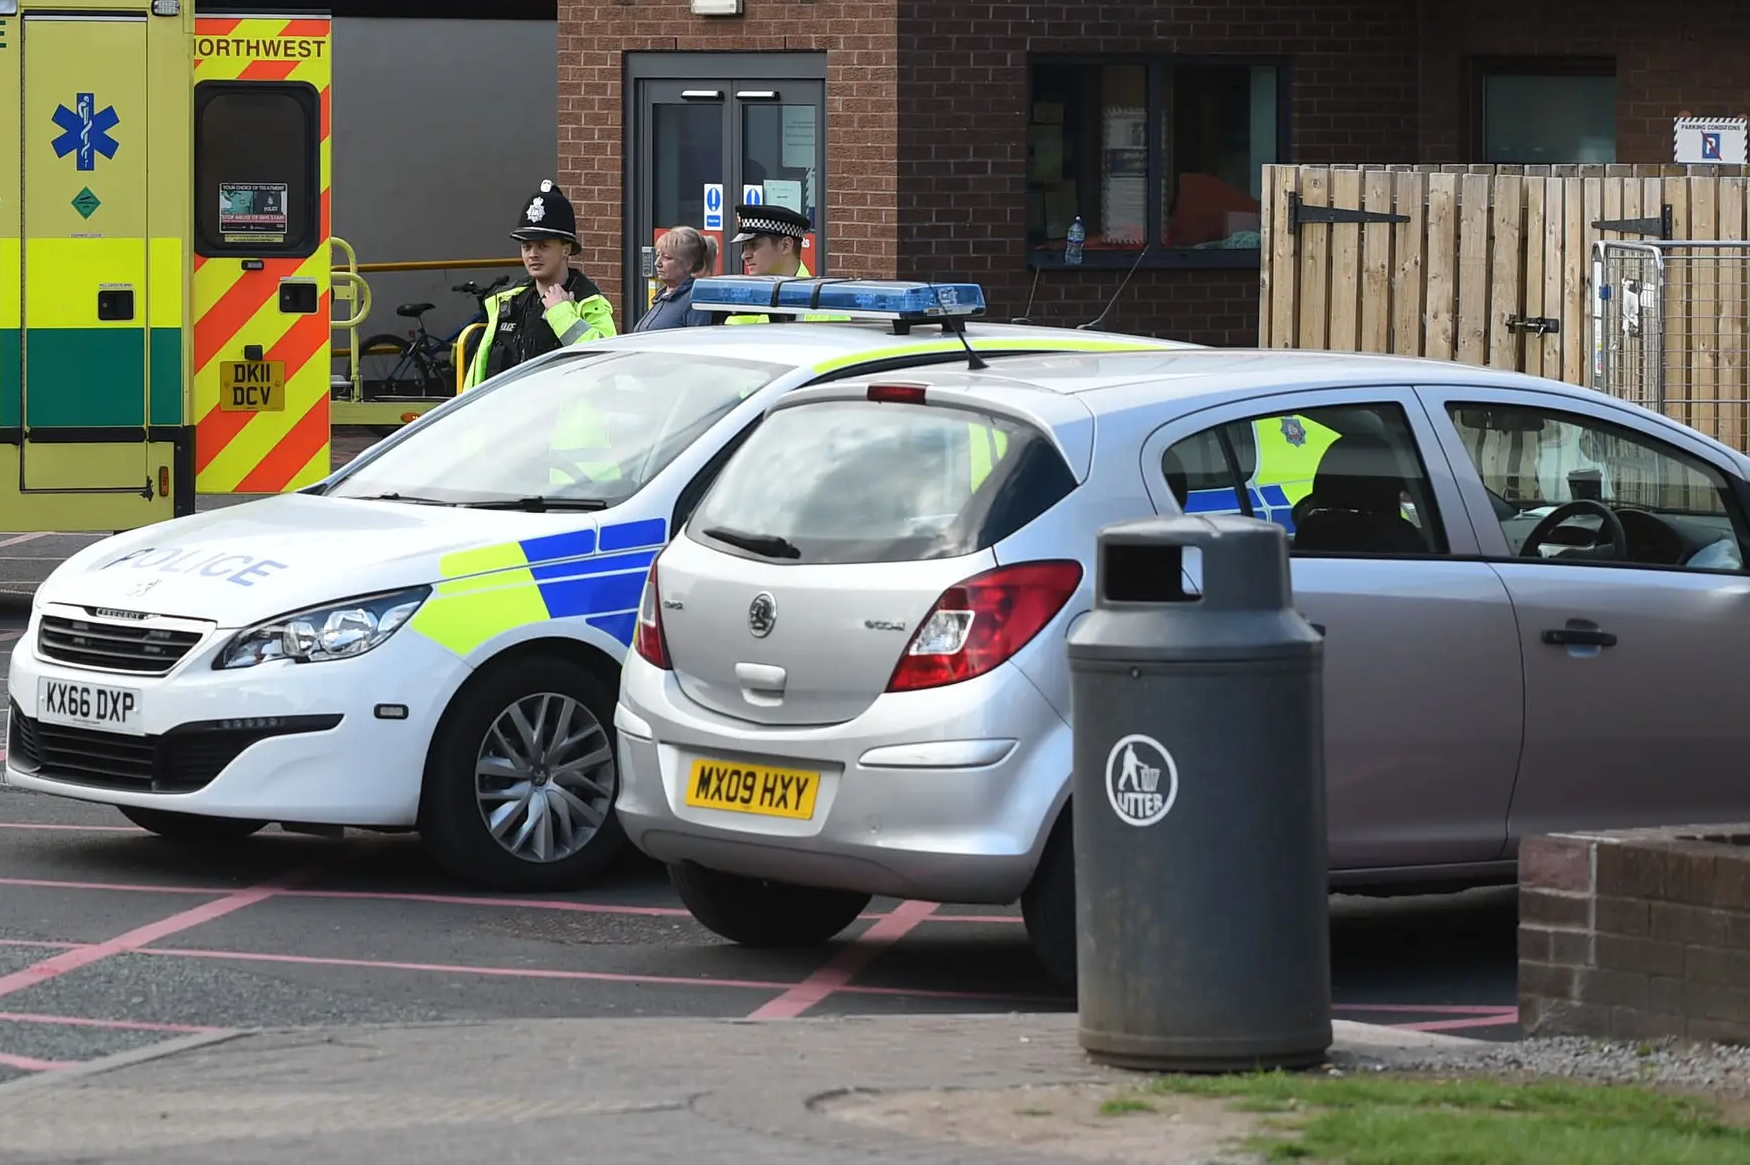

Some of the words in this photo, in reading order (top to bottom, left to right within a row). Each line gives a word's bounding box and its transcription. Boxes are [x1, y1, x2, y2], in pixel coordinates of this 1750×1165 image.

[194, 38, 326, 58] ORTHWEST
[500, 322, 516, 332] OLICE
[233, 363, 271, 383] DK11
[232, 386, 271, 406] DCV
[100, 547, 289, 587] POLICE
[46, 681, 91, 718] KX66
[96, 688, 135, 723] DXP
[695, 764, 757, 804] MX09
[759, 772, 810, 811] HXY
[1117, 791, 1164, 818] LITTER
